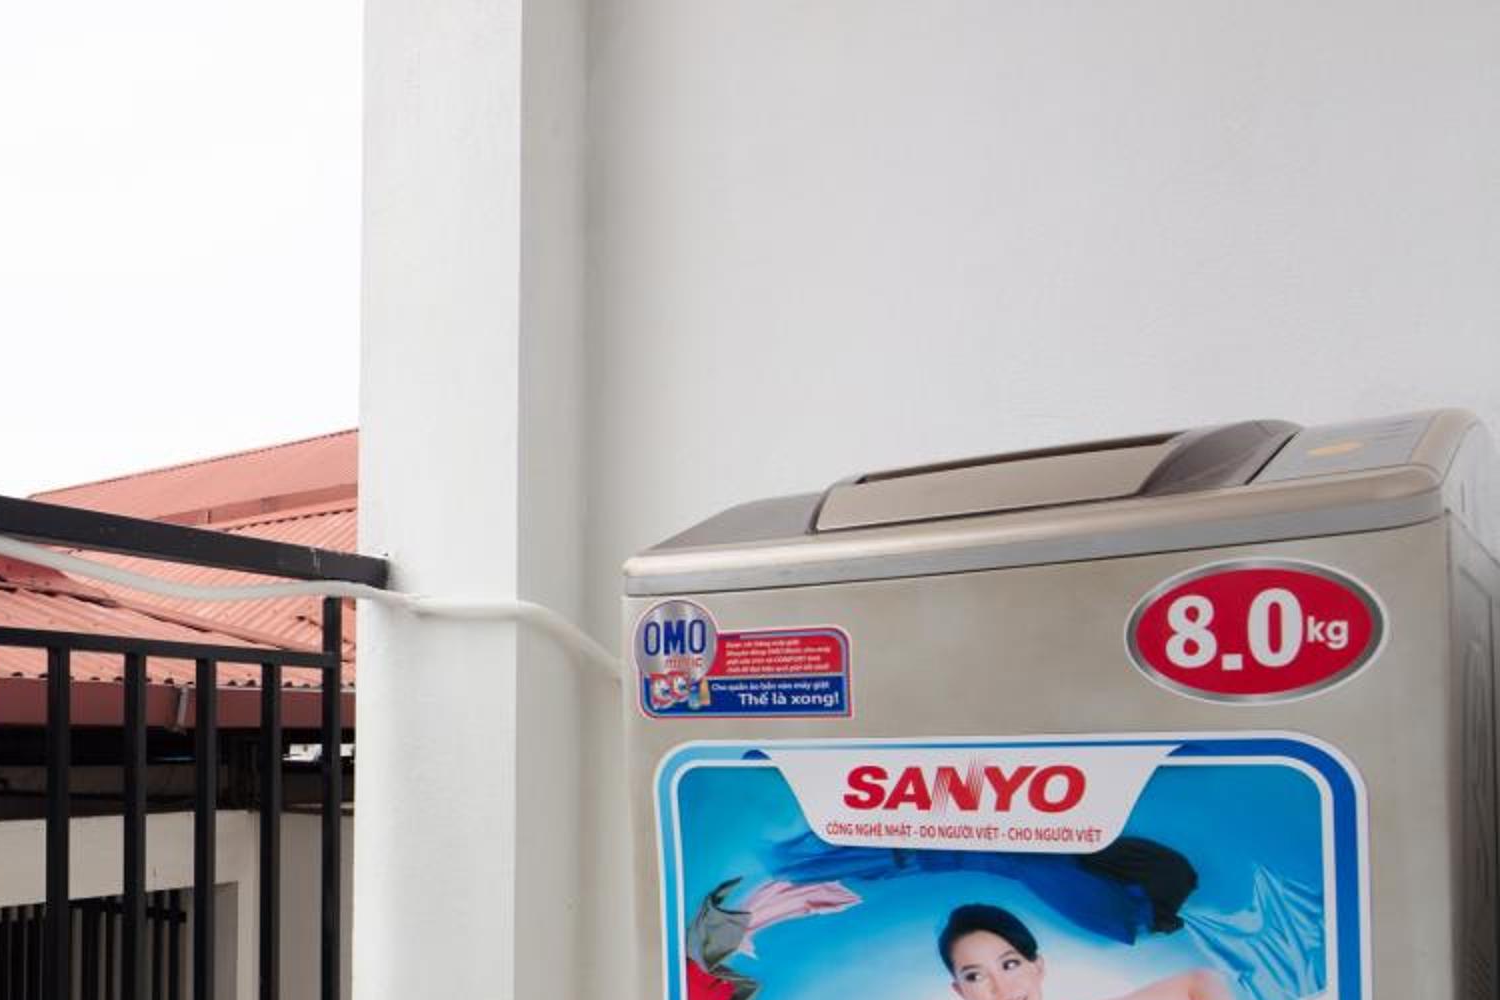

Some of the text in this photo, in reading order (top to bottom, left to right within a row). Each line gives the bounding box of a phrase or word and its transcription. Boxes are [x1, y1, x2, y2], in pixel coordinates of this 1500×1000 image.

[643, 619, 707, 656] OMO
[738, 691, 839, 707] Thế là xong!
[843, 760, 1087, 814] SANYO
[1008, 826, 1033, 841] CHO
